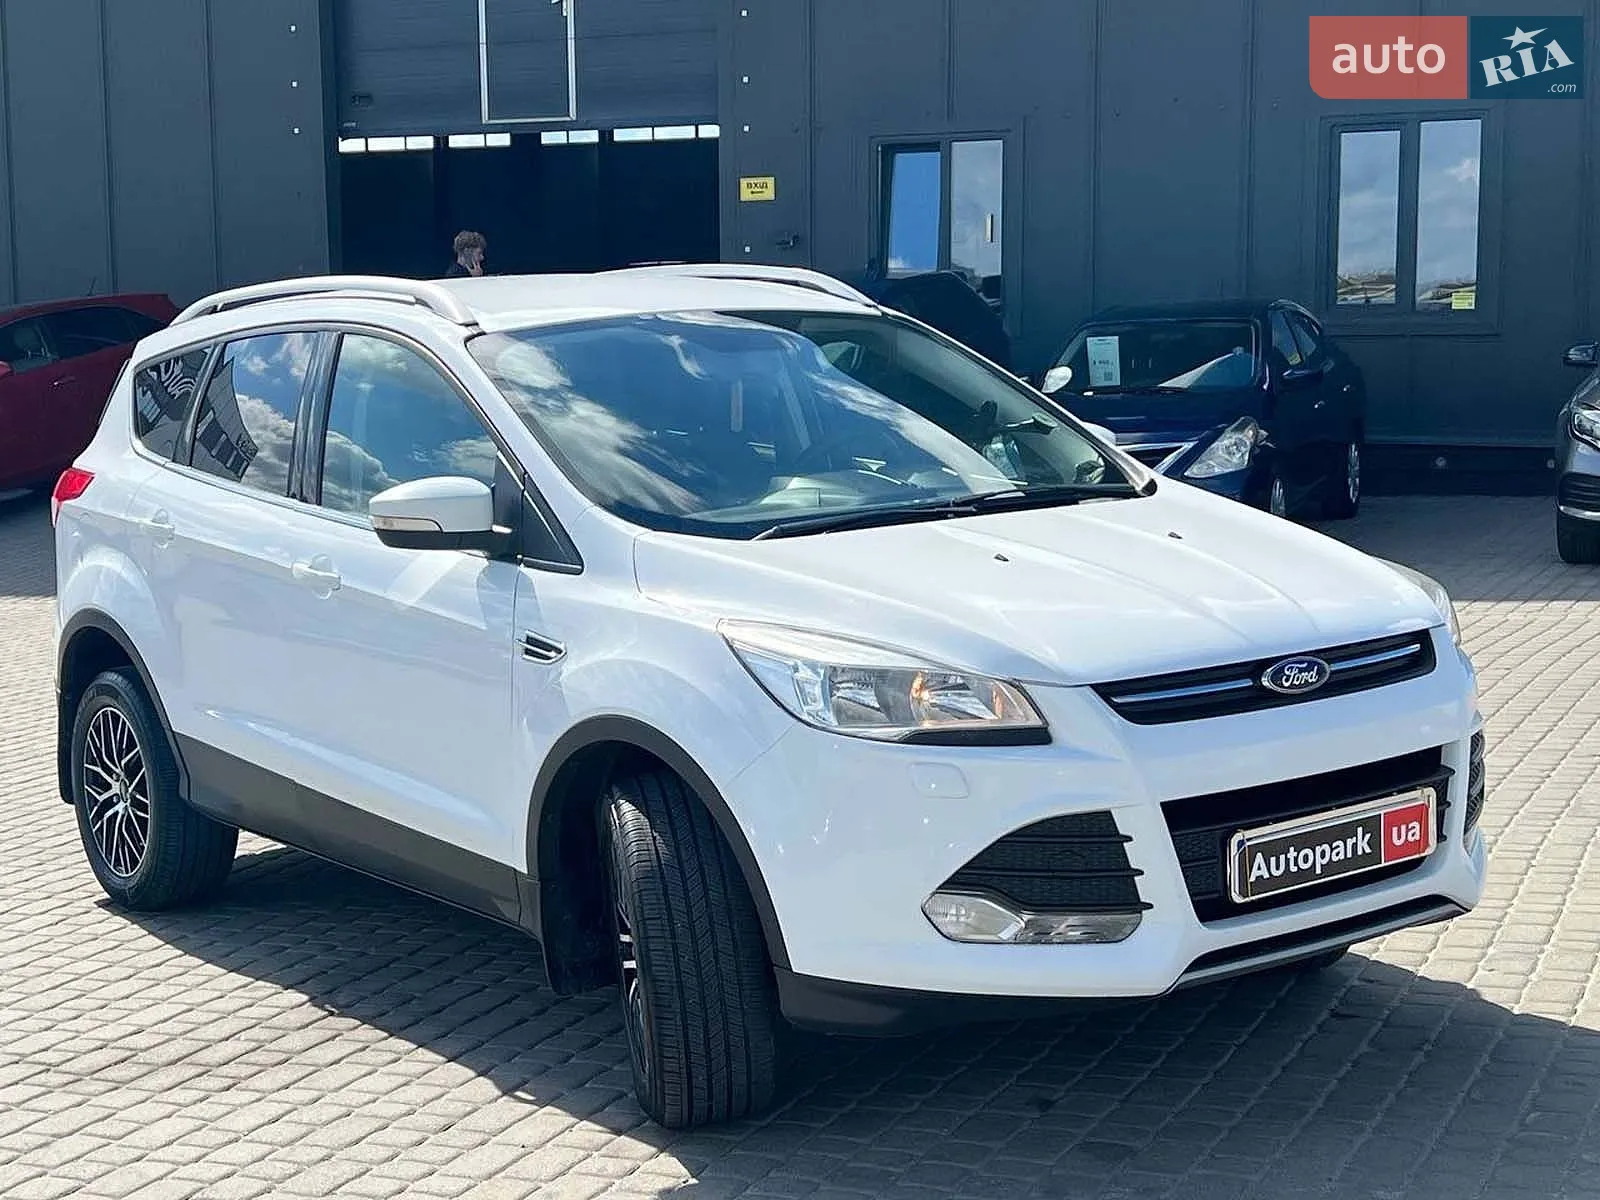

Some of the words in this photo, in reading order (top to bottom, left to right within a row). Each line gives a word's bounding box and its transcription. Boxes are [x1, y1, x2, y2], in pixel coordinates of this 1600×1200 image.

[1281, 662, 1319, 687] Ford
[1249, 826, 1372, 882] Autopark
[1391, 820, 1421, 847] ua
